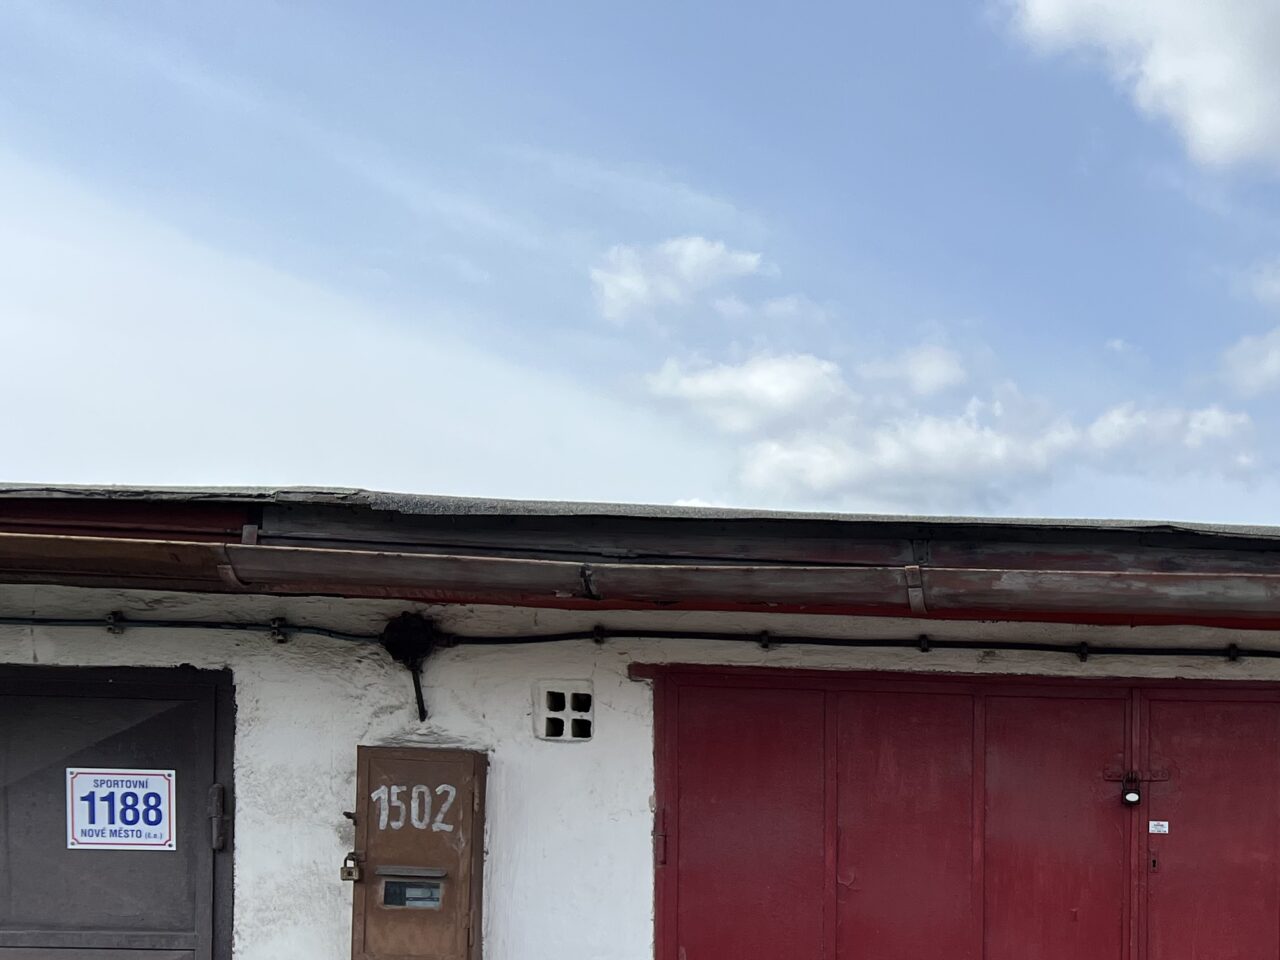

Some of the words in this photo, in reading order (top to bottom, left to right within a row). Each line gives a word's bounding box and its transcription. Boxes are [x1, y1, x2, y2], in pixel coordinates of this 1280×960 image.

[93, 778, 148, 789] SPORTOVNÍ
[80, 791, 163, 826] 1188
[371, 784, 456, 832] 1502
[80, 827, 107, 838] NOVÉ
[109, 827, 142, 839] MĚSTO
